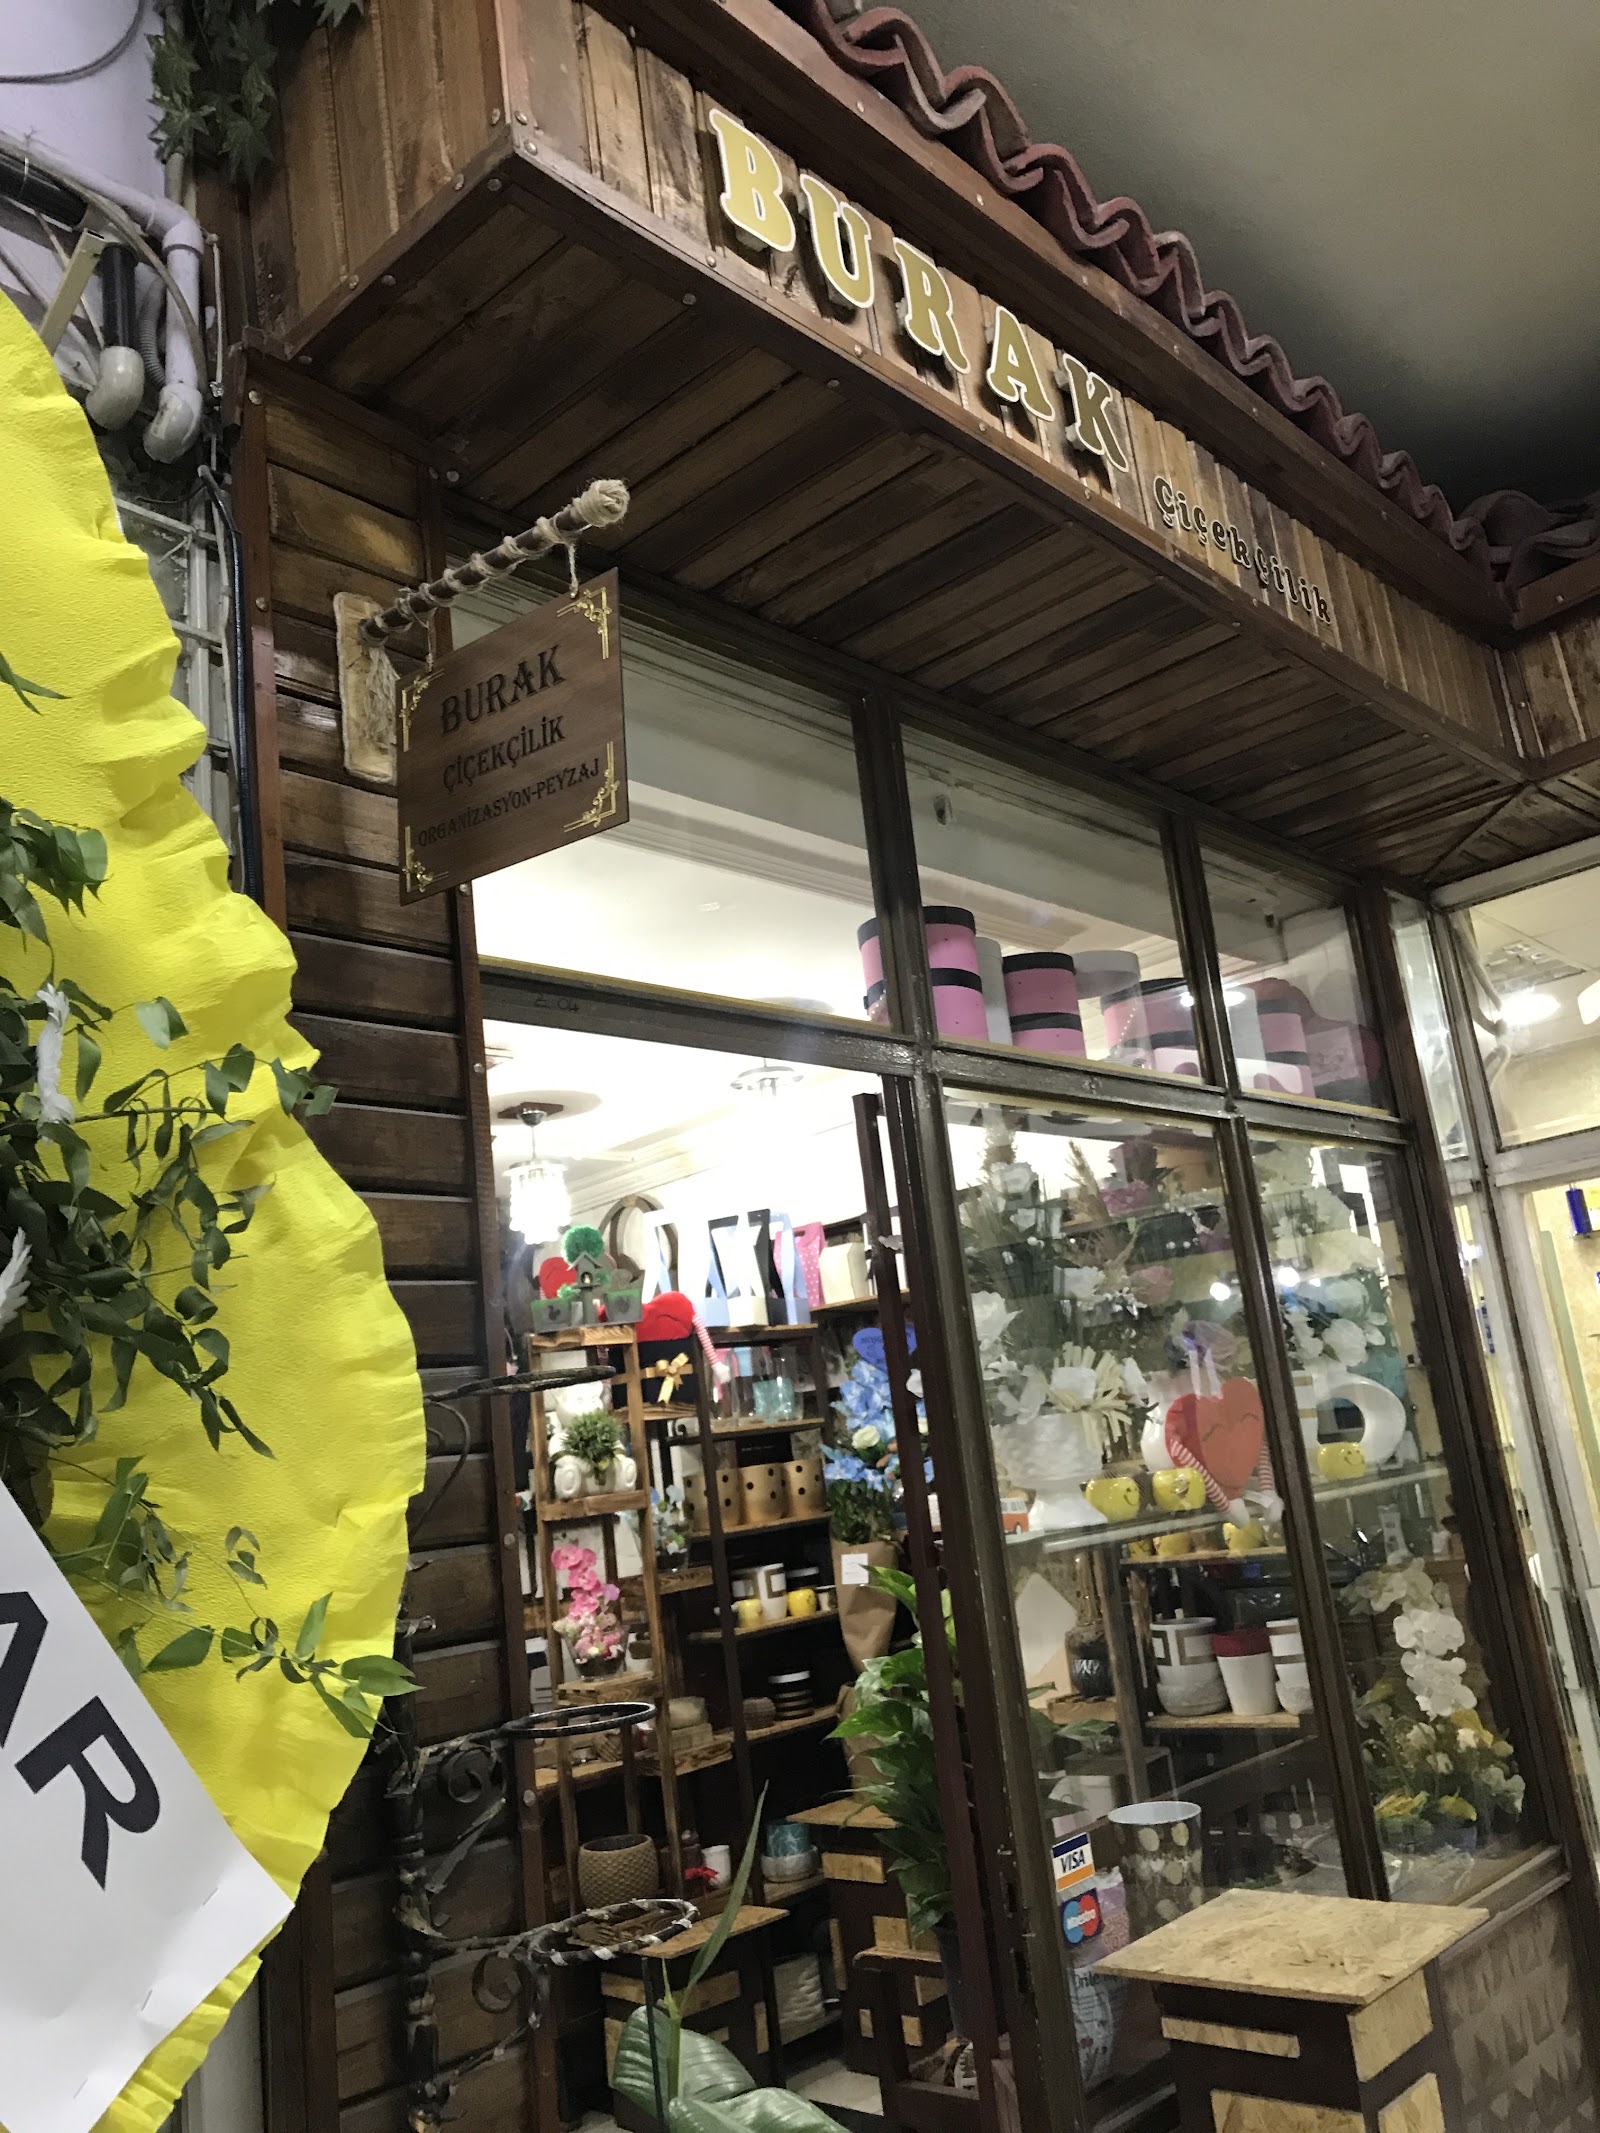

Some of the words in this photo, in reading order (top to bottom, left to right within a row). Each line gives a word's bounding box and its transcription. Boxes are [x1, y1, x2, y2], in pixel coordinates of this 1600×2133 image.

[709, 108, 1130, 473] BURAK
[1153, 476, 1331, 624] Çiçekçilik
[441, 644, 566, 735] BURAK
[443, 716, 565, 793] ÇİÇEKÇİLİK
[418, 758, 600, 846] ORGANİZASYON-PEYZAJ
[1061, 1849, 1085, 1873] VISA
